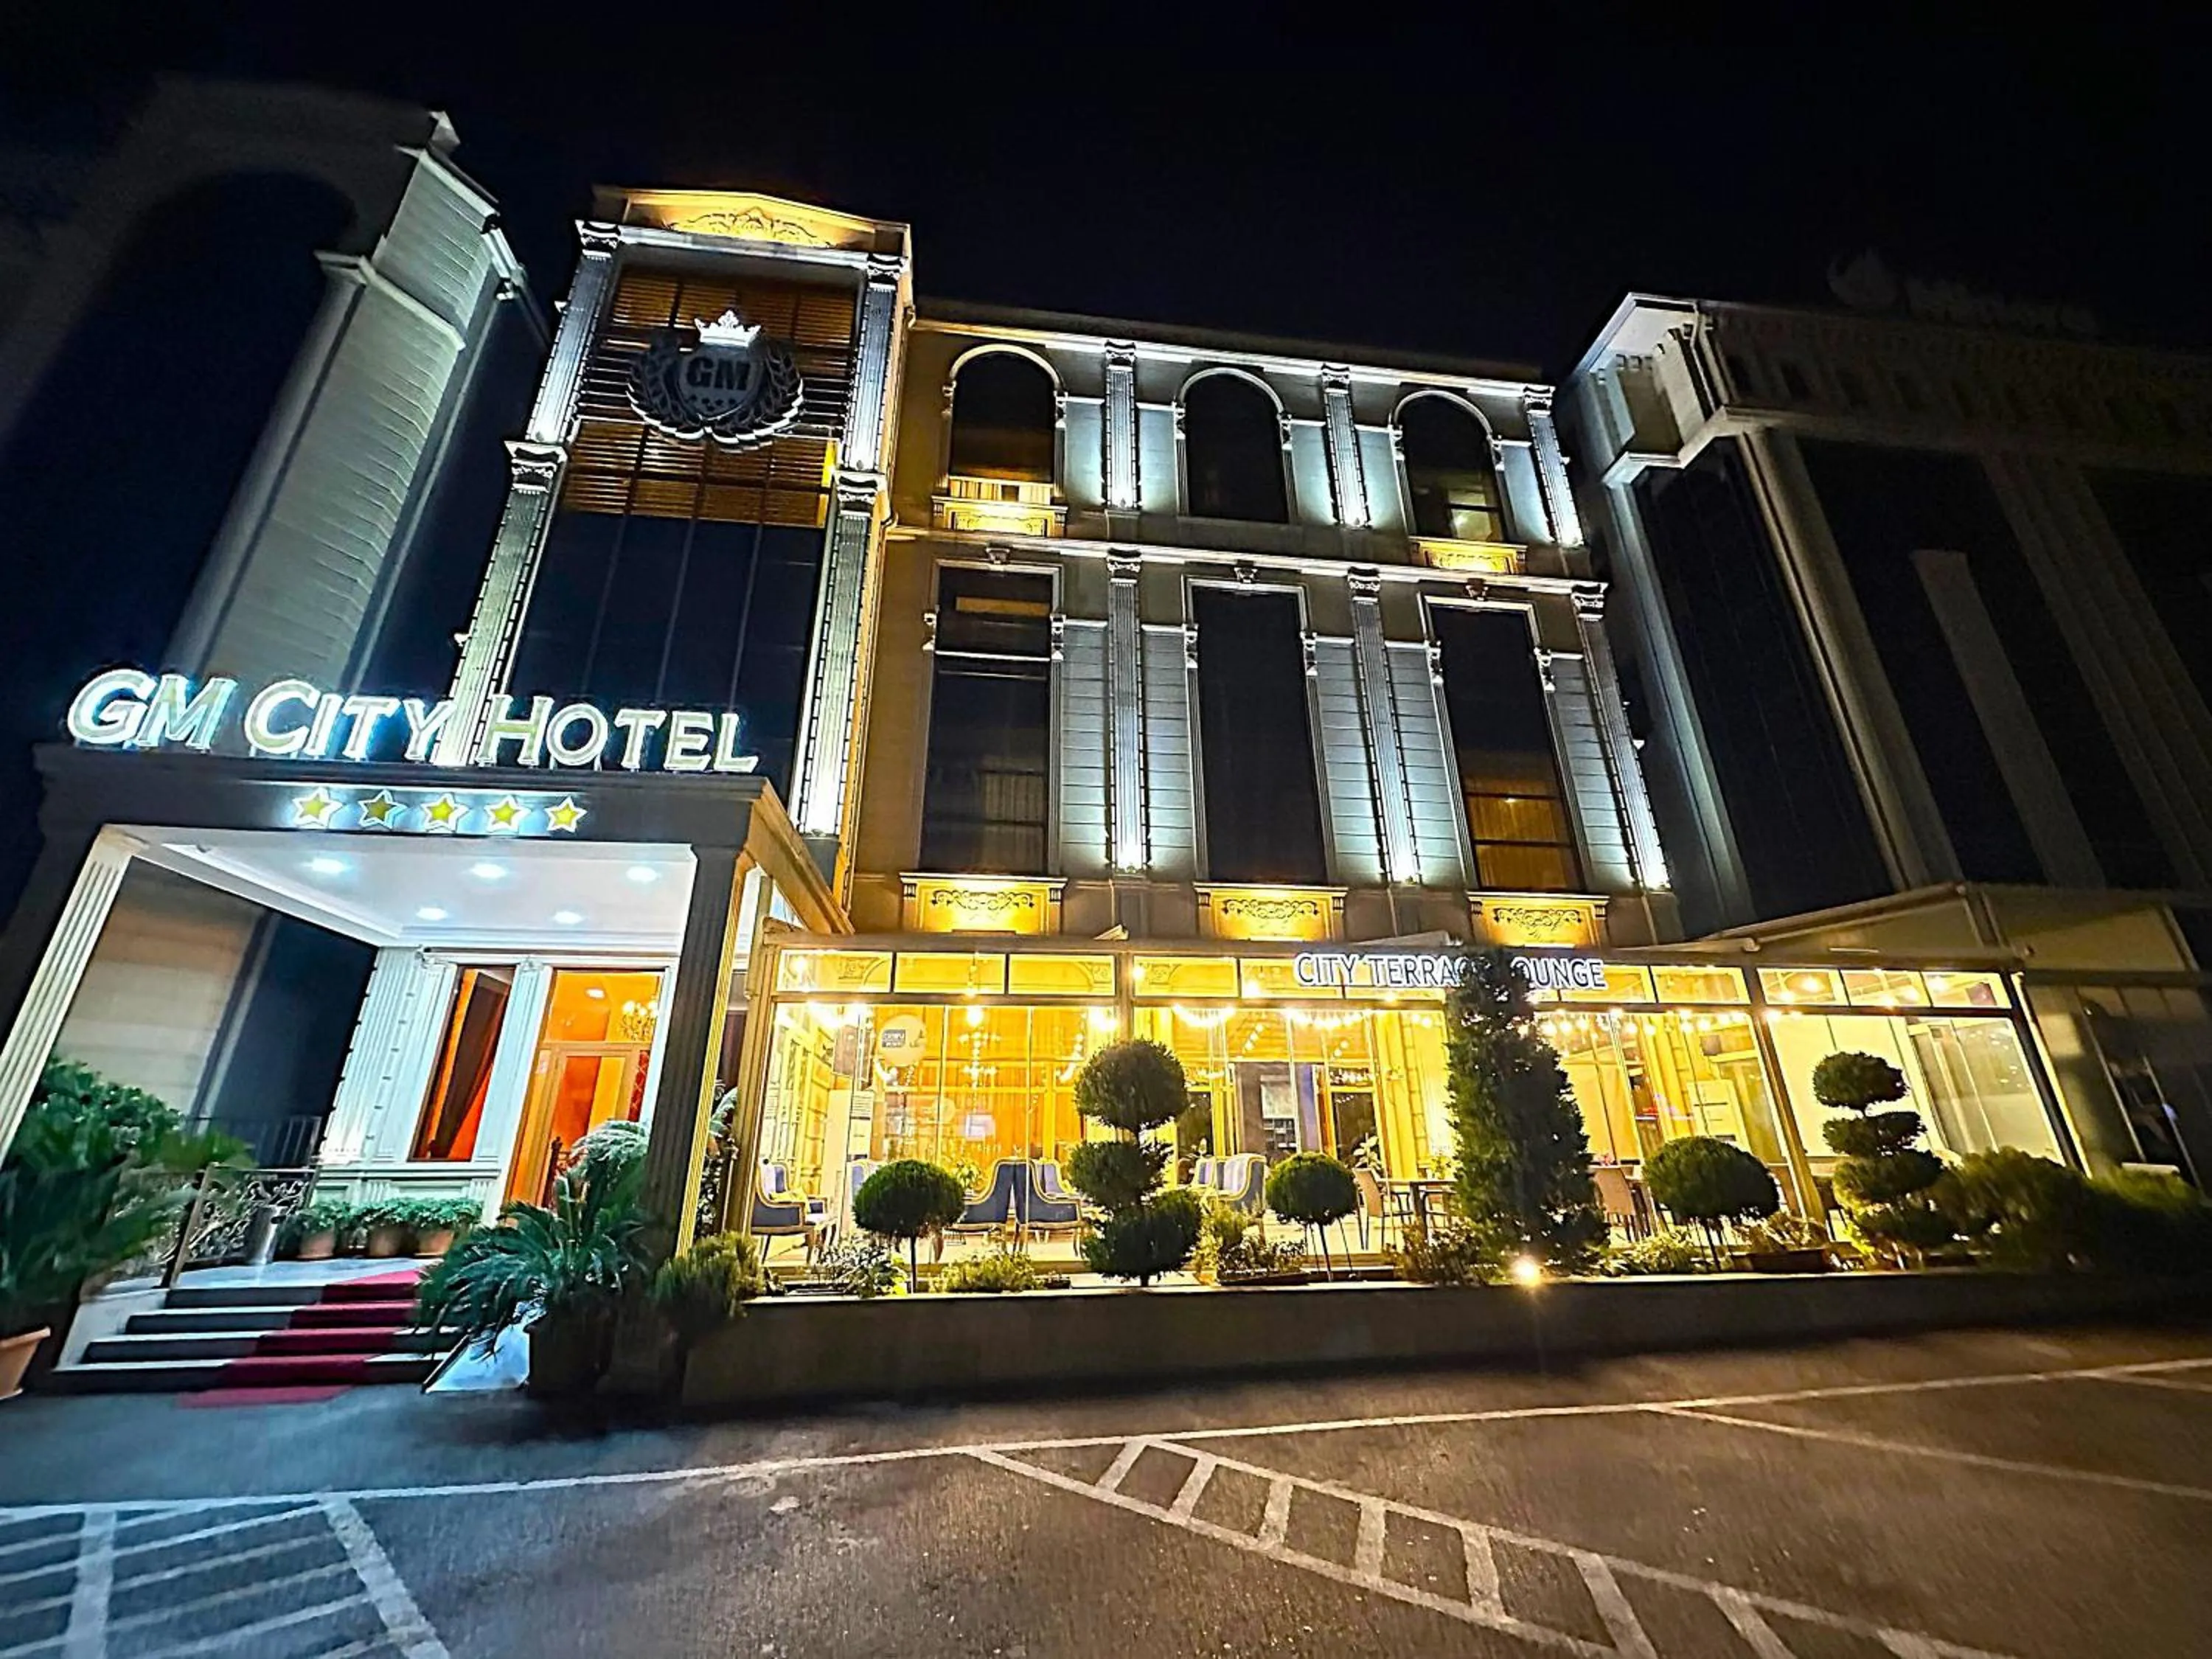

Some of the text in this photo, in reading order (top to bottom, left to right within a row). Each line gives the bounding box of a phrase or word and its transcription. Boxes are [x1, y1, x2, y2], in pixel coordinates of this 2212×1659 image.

[686, 357, 751, 391] GM
[67, 669, 759, 773] GM CITY HOTEL
[1295, 953, 1607, 990] CITY TERRAC OUNGE
